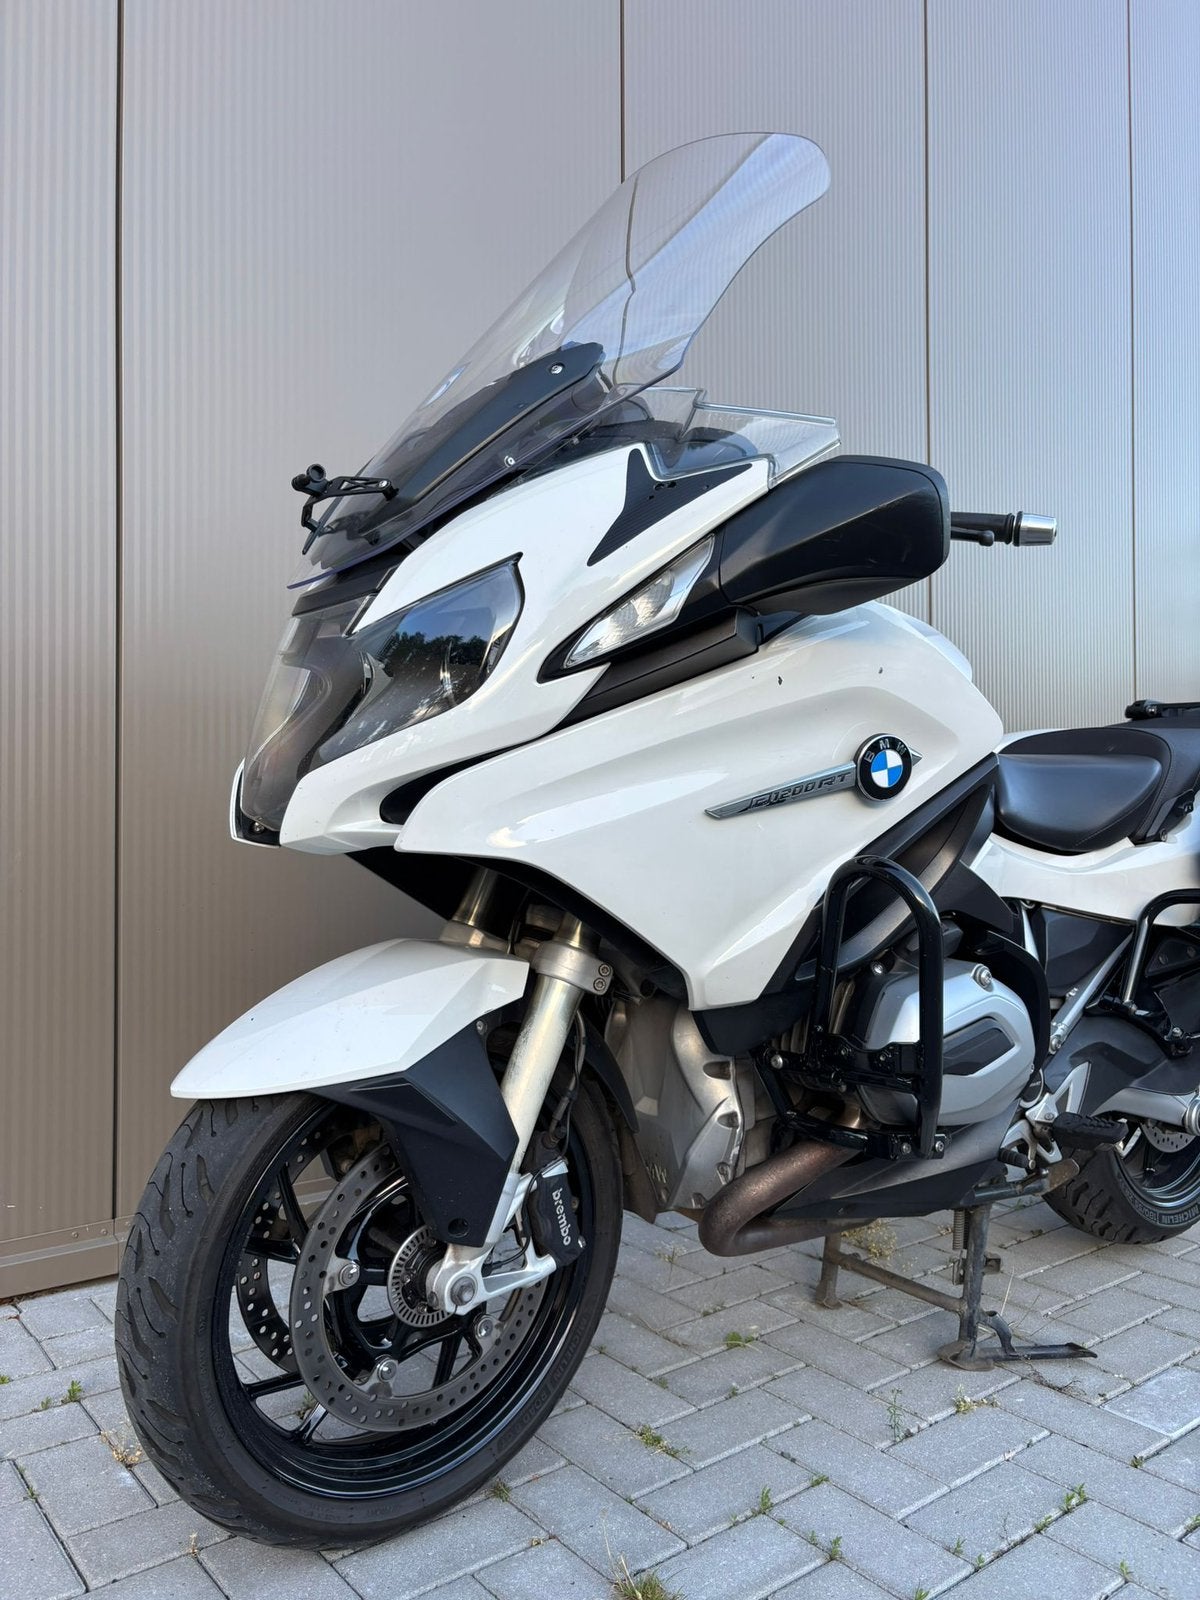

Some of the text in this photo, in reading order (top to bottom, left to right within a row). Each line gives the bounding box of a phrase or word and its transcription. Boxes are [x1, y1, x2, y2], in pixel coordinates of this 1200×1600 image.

[864, 738, 907, 763] BMW
[552, 1187, 572, 1246] brembo
[1161, 1204, 1199, 1224] MICHELIN
